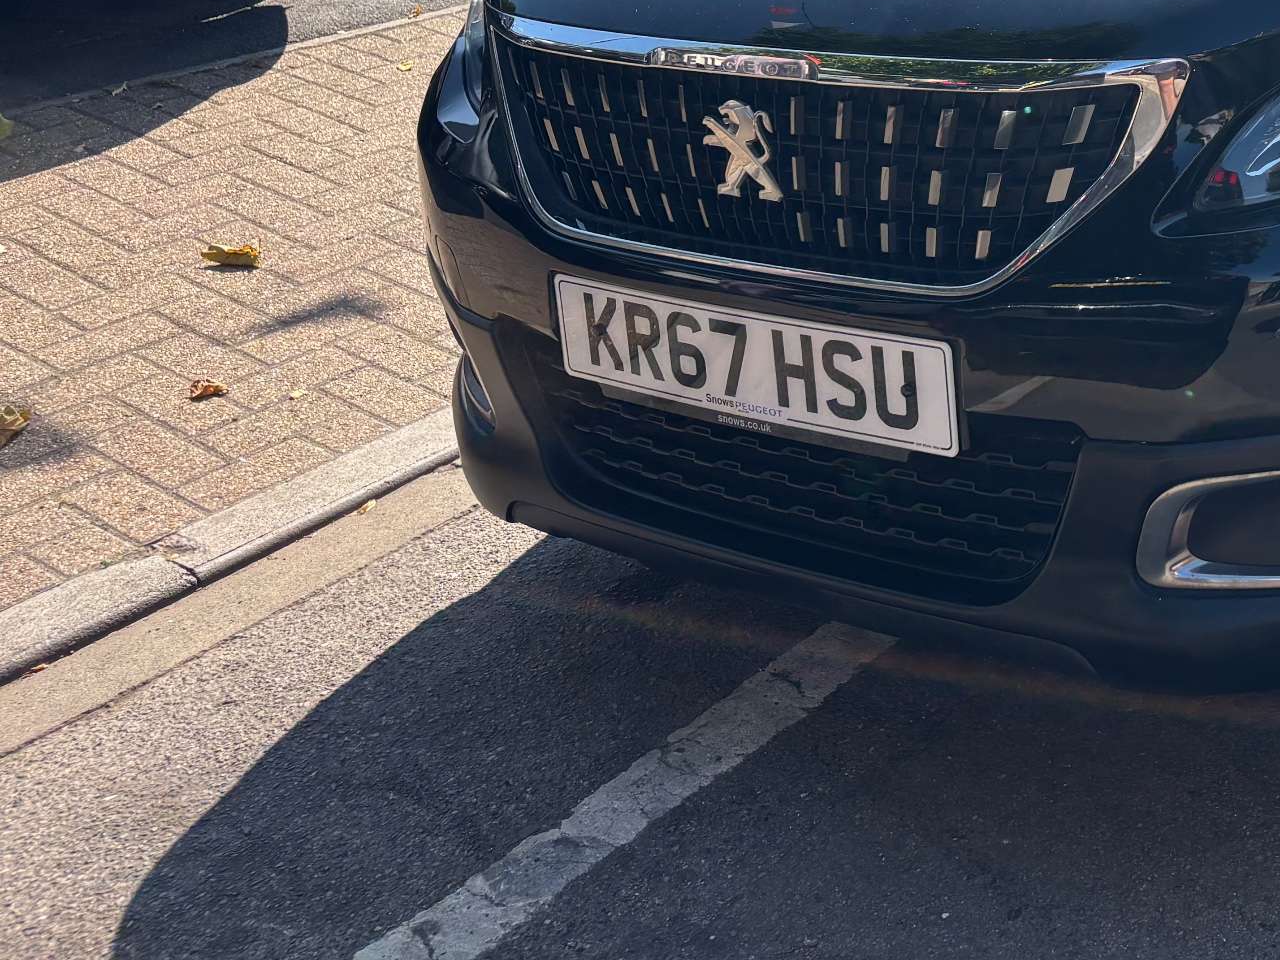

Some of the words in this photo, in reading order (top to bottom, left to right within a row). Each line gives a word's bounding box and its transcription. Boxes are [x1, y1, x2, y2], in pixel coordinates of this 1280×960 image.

[582, 292, 748, 398] KR67
[770, 329, 920, 430] HSU
[705, 393, 735, 409] Snows
[735, 401, 783, 418] PEUGEOT
[717, 414, 772, 433] snows.co.uk
